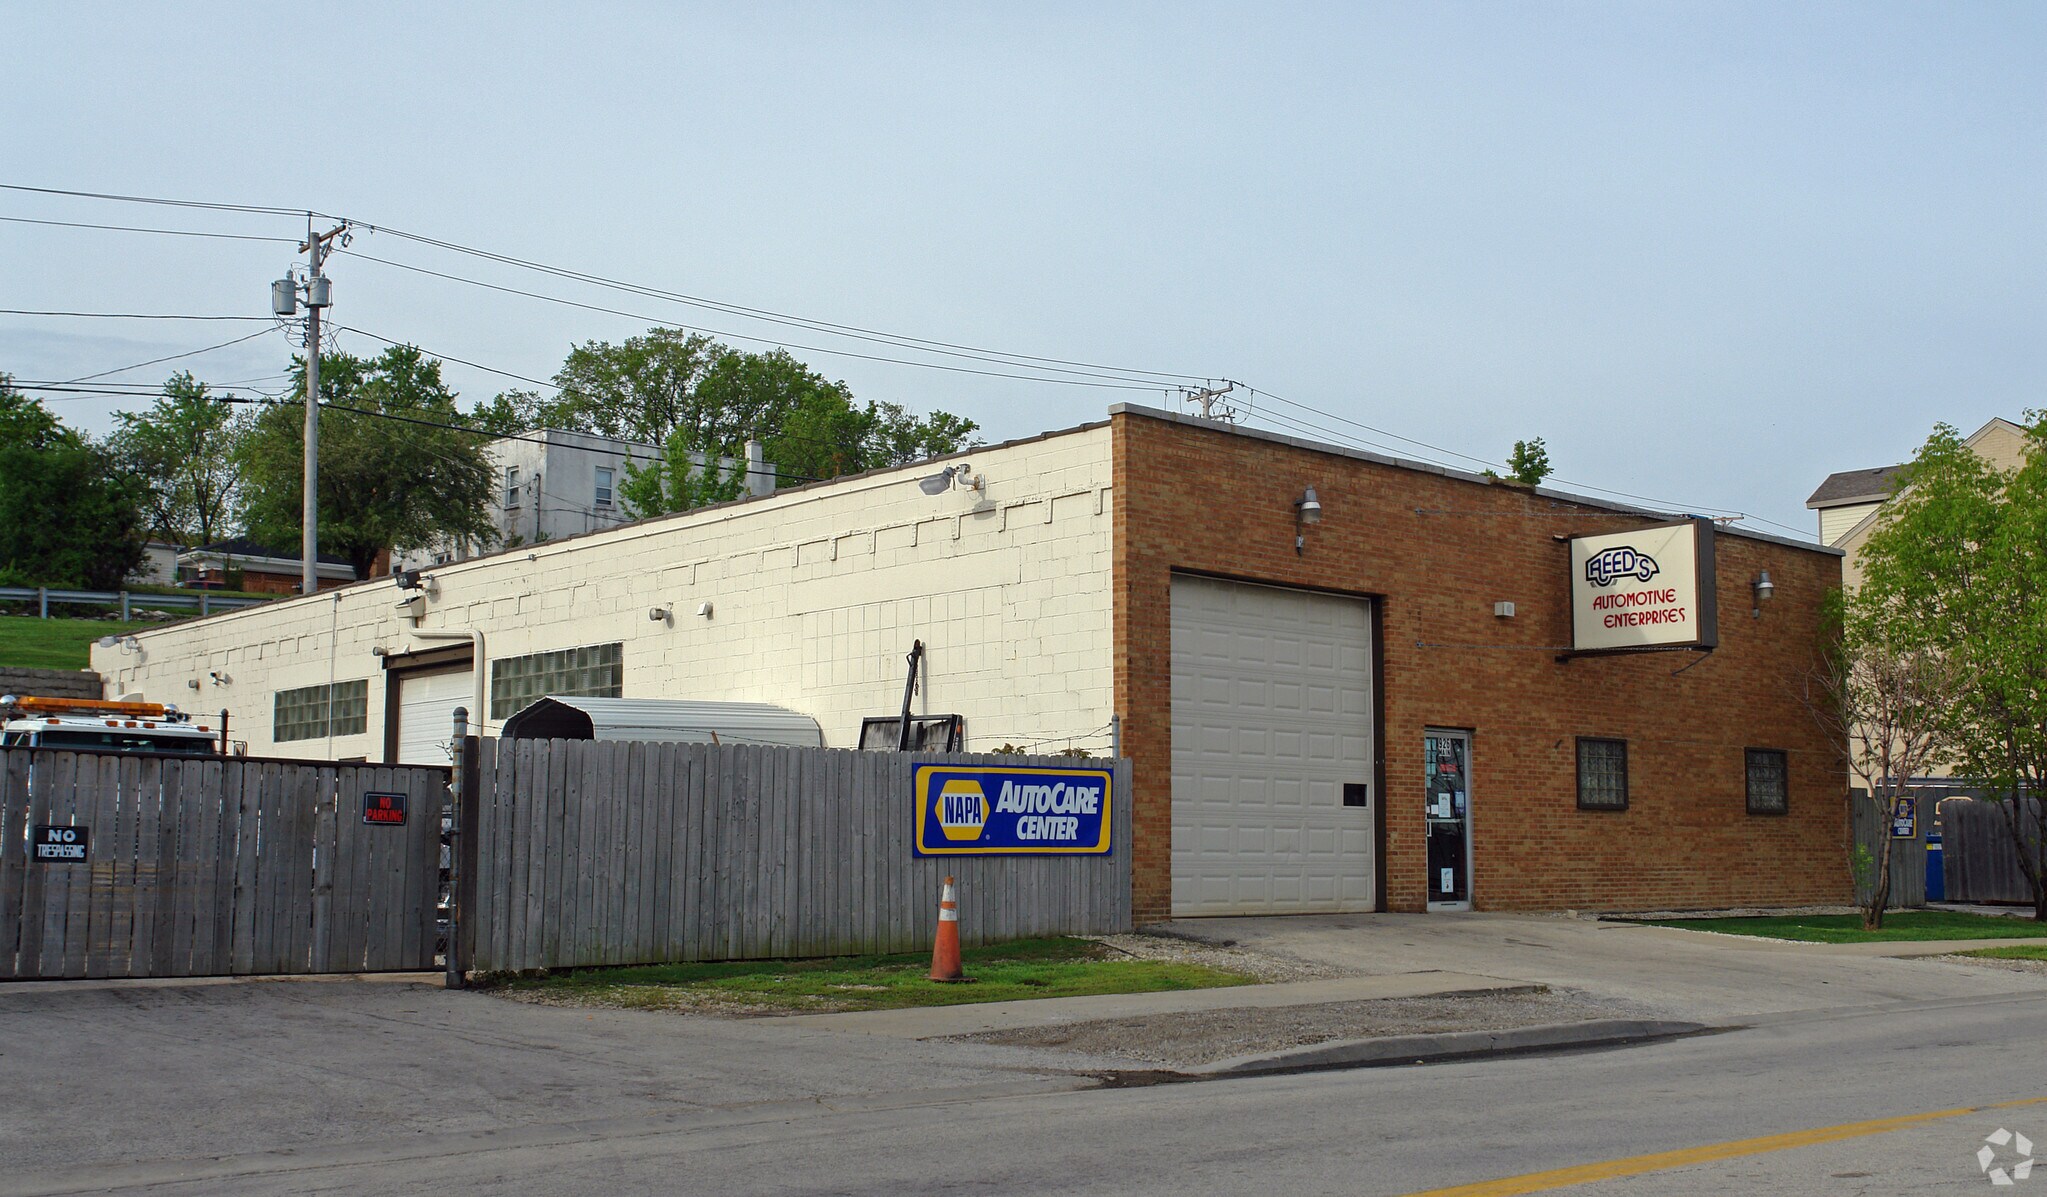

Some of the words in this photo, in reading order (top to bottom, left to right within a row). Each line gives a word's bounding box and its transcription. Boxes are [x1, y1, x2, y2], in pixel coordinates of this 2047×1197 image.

[1590, 551, 1650, 582] REED'S
[1593, 589, 1676, 610] AUTOMOTIVE
[1604, 608, 1685, 628] ENTERPRISES
[380, 797, 392, 809] NO
[995, 780, 1100, 814] AUTOCARE
[367, 808, 403, 822] PARKING
[944, 796, 982, 824] NAPA
[48, 829, 76, 842] NO
[1016, 815, 1079, 840] CENTER
[37, 844, 85, 858] TRESPASSING
